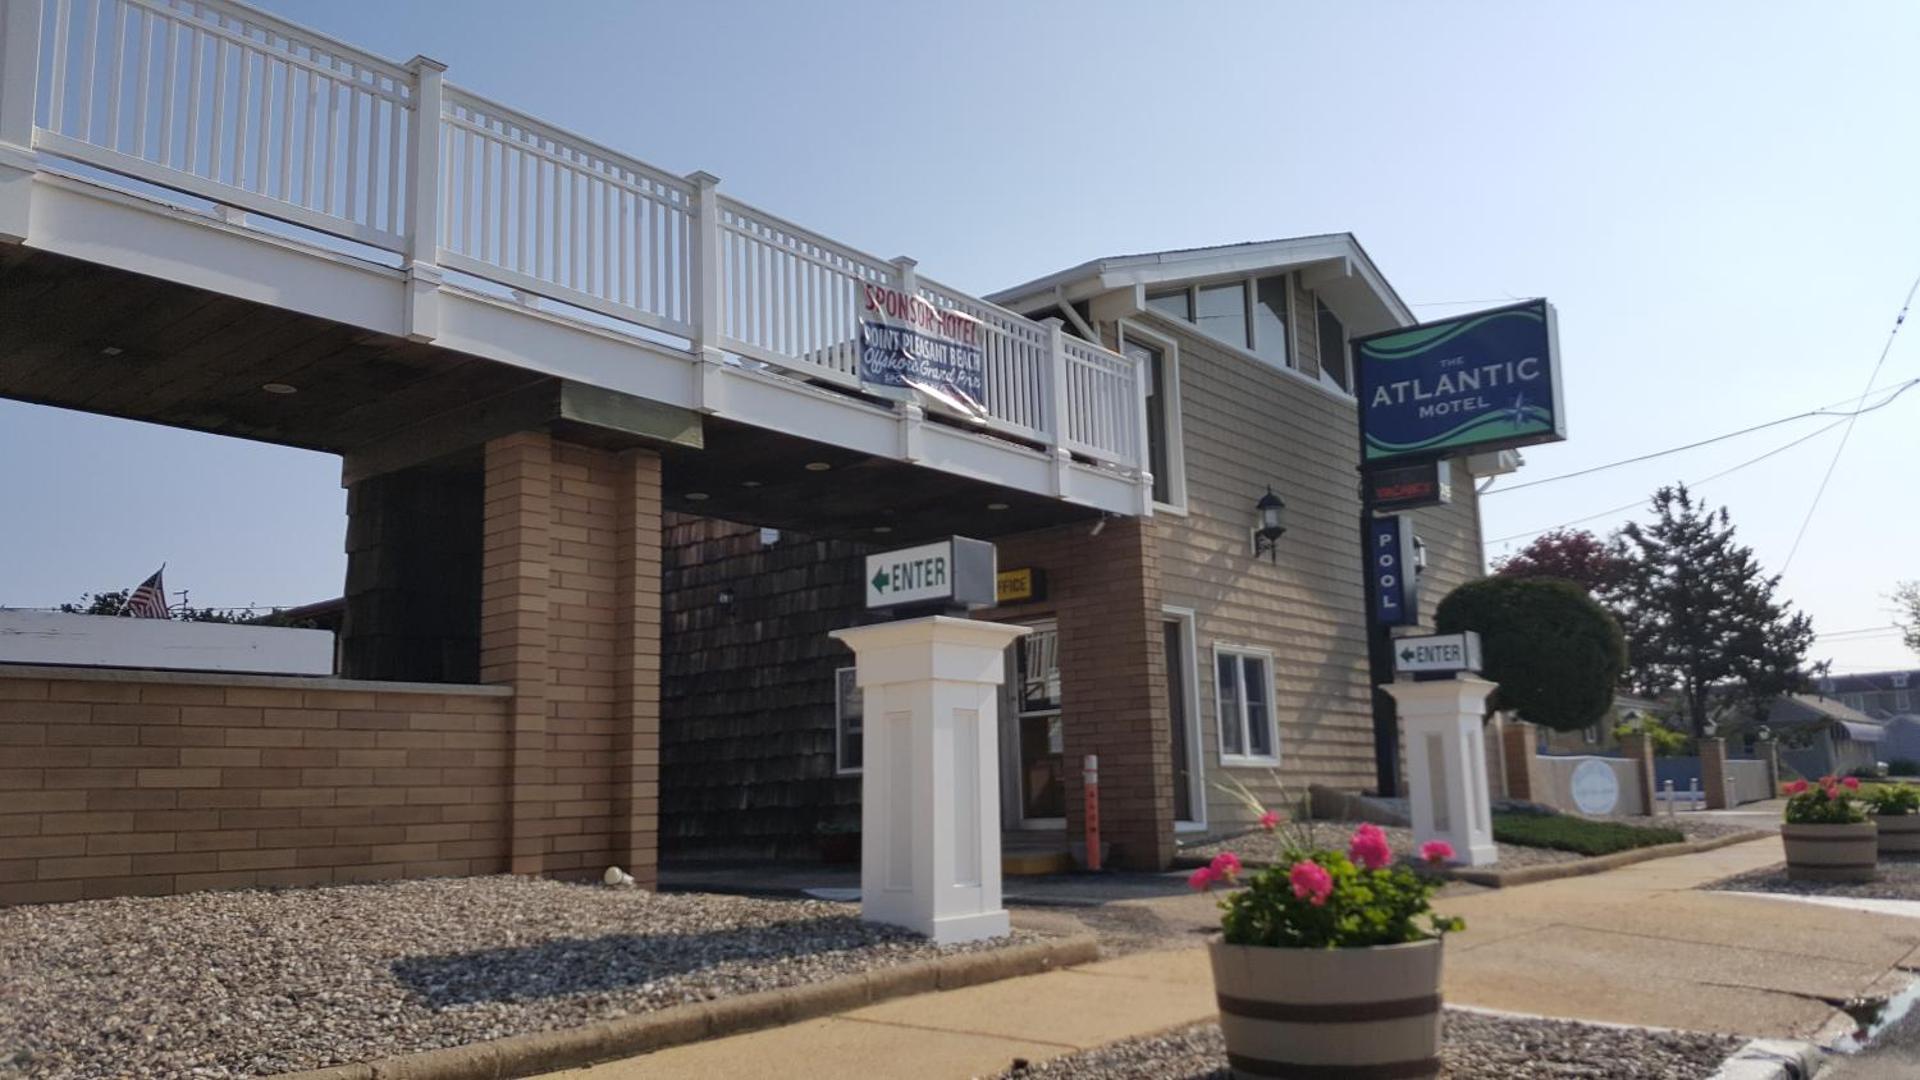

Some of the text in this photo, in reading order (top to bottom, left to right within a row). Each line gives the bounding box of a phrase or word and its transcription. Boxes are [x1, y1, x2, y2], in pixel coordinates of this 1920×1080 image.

[864, 284, 977, 345] SPONSOR HOTEL
[865, 325, 981, 372] POINT PLEASANT BEACH
[1440, 356, 1464, 367] THE
[920, 360, 955, 383] Grand
[1371, 357, 1541, 408] ATLANTIC
[1419, 396, 1491, 419] MOTEL
[892, 557, 946, 592] ENTER
[1379, 534, 1397, 608] POOL
[1416, 644, 1460, 663] ENTER
